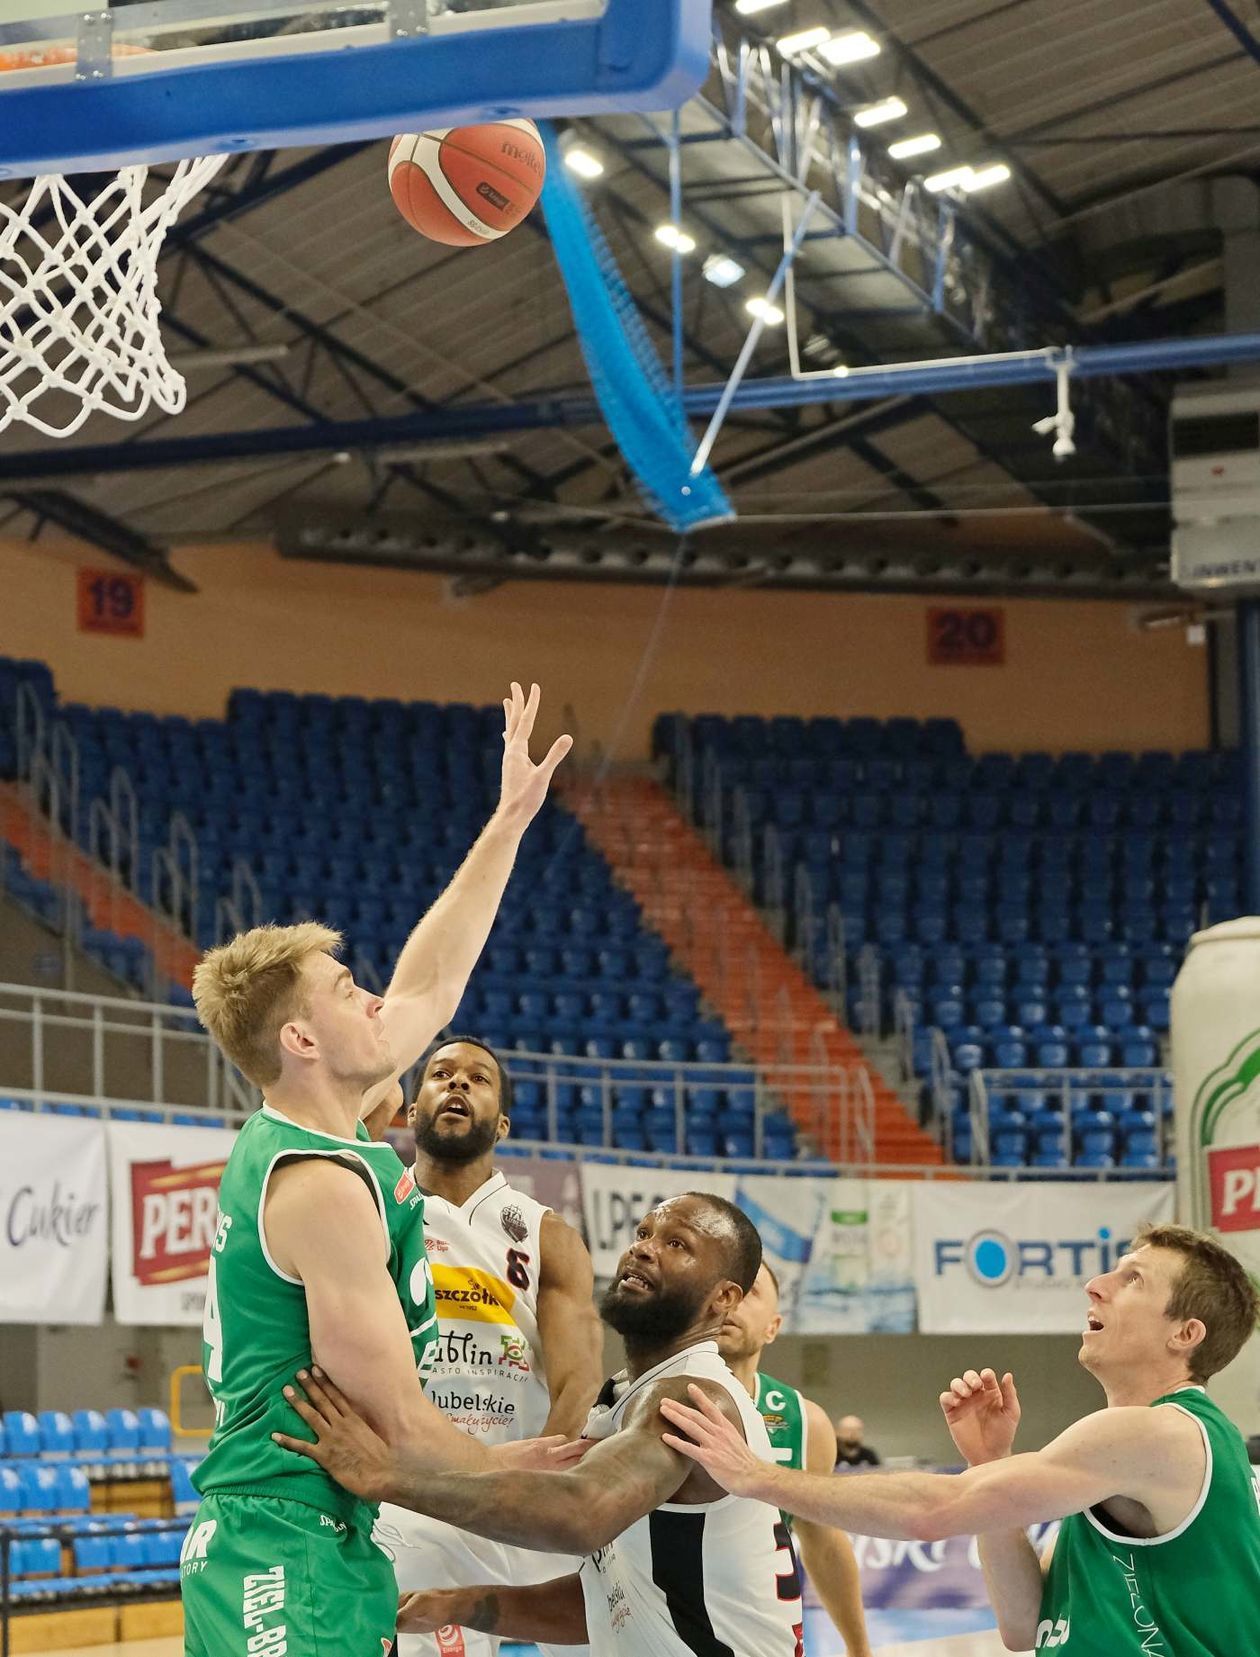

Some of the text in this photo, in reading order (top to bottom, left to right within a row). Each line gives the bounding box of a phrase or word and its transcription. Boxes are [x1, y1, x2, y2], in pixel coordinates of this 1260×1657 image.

[91, 577, 134, 619] 19
[935, 611, 997, 655] 20
[6, 1178, 99, 1247] Cukier
[592, 1189, 663, 1251] LPE
[505, 1247, 531, 1292] 6
[765, 1390, 787, 1411] C
[182, 1560, 208, 1579] TORY
